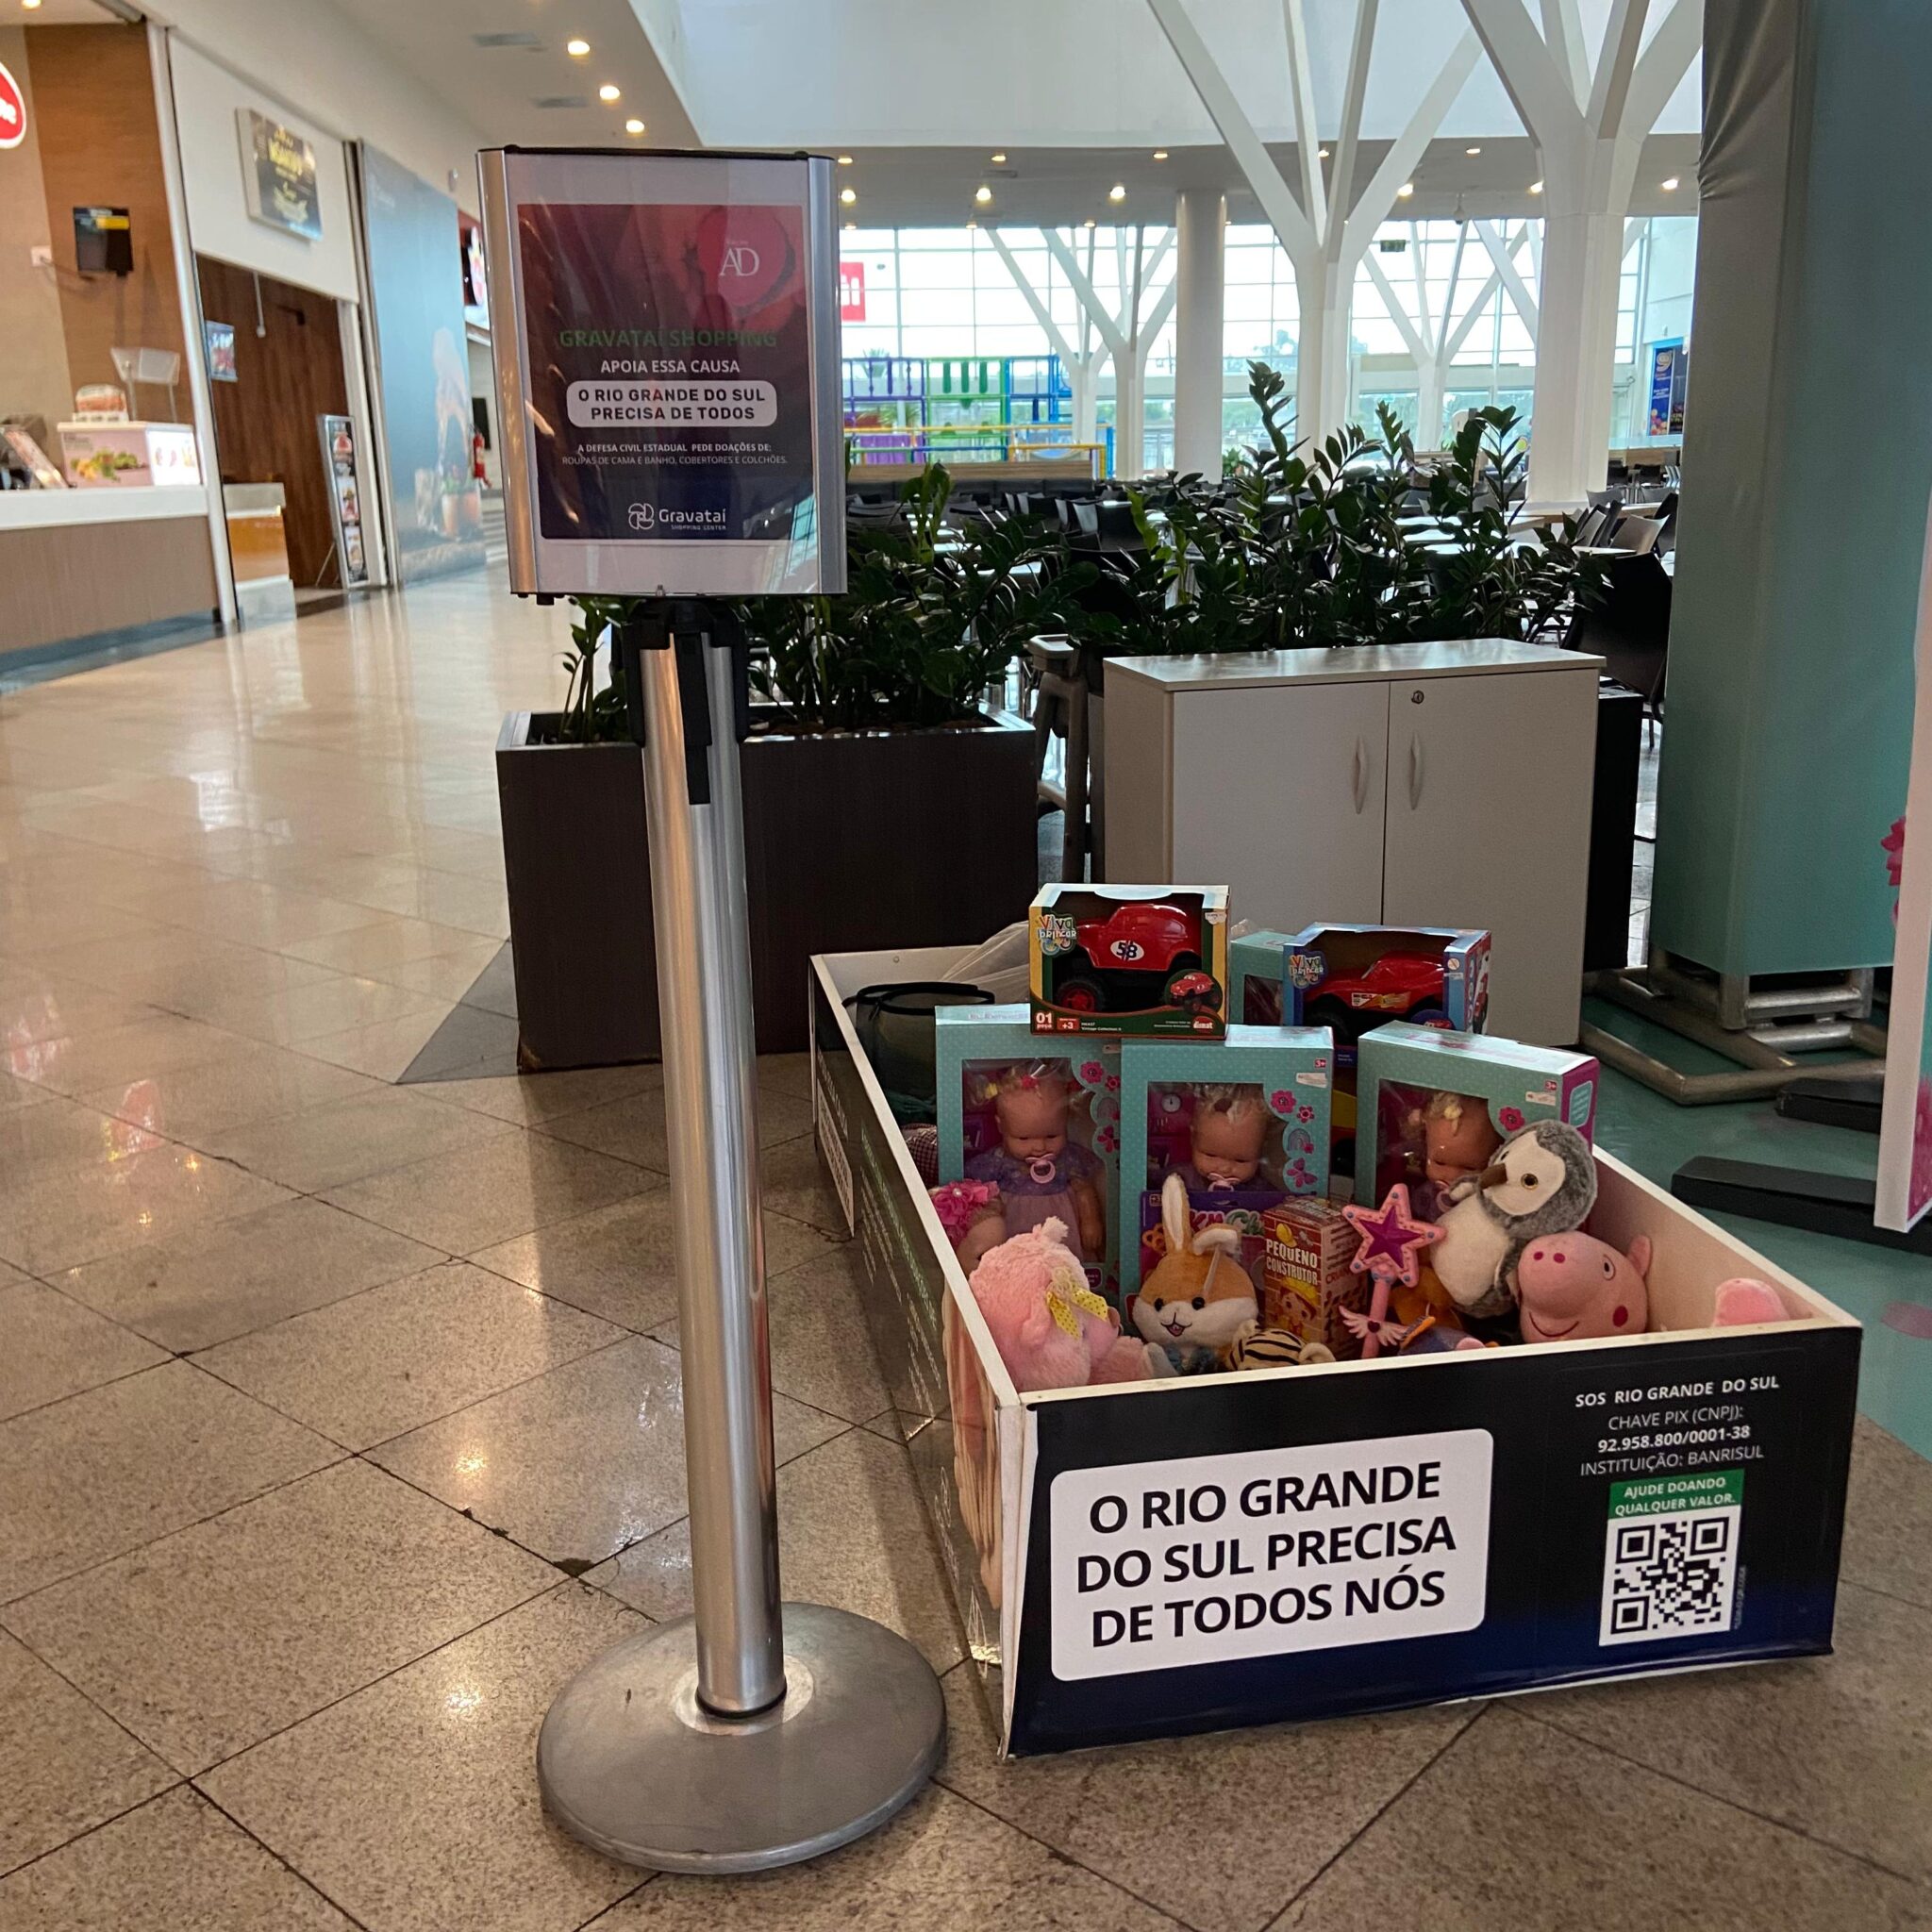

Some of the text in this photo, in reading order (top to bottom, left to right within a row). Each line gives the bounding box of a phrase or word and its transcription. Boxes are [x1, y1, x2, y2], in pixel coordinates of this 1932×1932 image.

[669, 330, 777, 348] SHOPPING
[600, 359, 741, 374] APOIA ESSA CAUSA
[578, 389, 766, 402] O RIO GRANDE DO SUL
[591, 407, 755, 421] PRECISA DE TODOS
[577, 444, 585, 453] A
[586, 443, 618, 453] DEFESA
[619, 443, 642, 453] CIVIL
[643, 443, 688, 453] ESTADUAL
[691, 443, 713, 452] PEDE
[715, 442, 756, 455] DOAÇÕES
[610, 457, 637, 465] CAMA
[678, 456, 734, 465] COBERTORES
[658, 508, 726, 523] Gravataí
[1116, 941, 1138, 959] 58
[1036, 1012, 1053, 1024] 01
[1266, 1239, 1318, 1269] PEQUENO
[1266, 1256, 1318, 1286] CONSTRUTOR
[1574, 1375, 1780, 1407] SOS RIO GRANDE DO SUL
[1607, 1405, 1743, 1431] CHAVE PIX (CNPJ):
[1597, 1424, 1751, 1454] 92.958.800/0001-38
[1580, 1444, 1764, 1476] INSTITUIÇÃO: BANRISUL
[1089, 1461, 1441, 1534] O RIO GRANDE
[1624, 1476, 1726, 1499] AJUDE DOANDO
[1615, 1492, 1736, 1517] QUALQUER VALOR.
[1077, 1515, 1457, 1593] DO SUL PRECISA
[1092, 1563, 1446, 1648] DE TODOS NÓS
